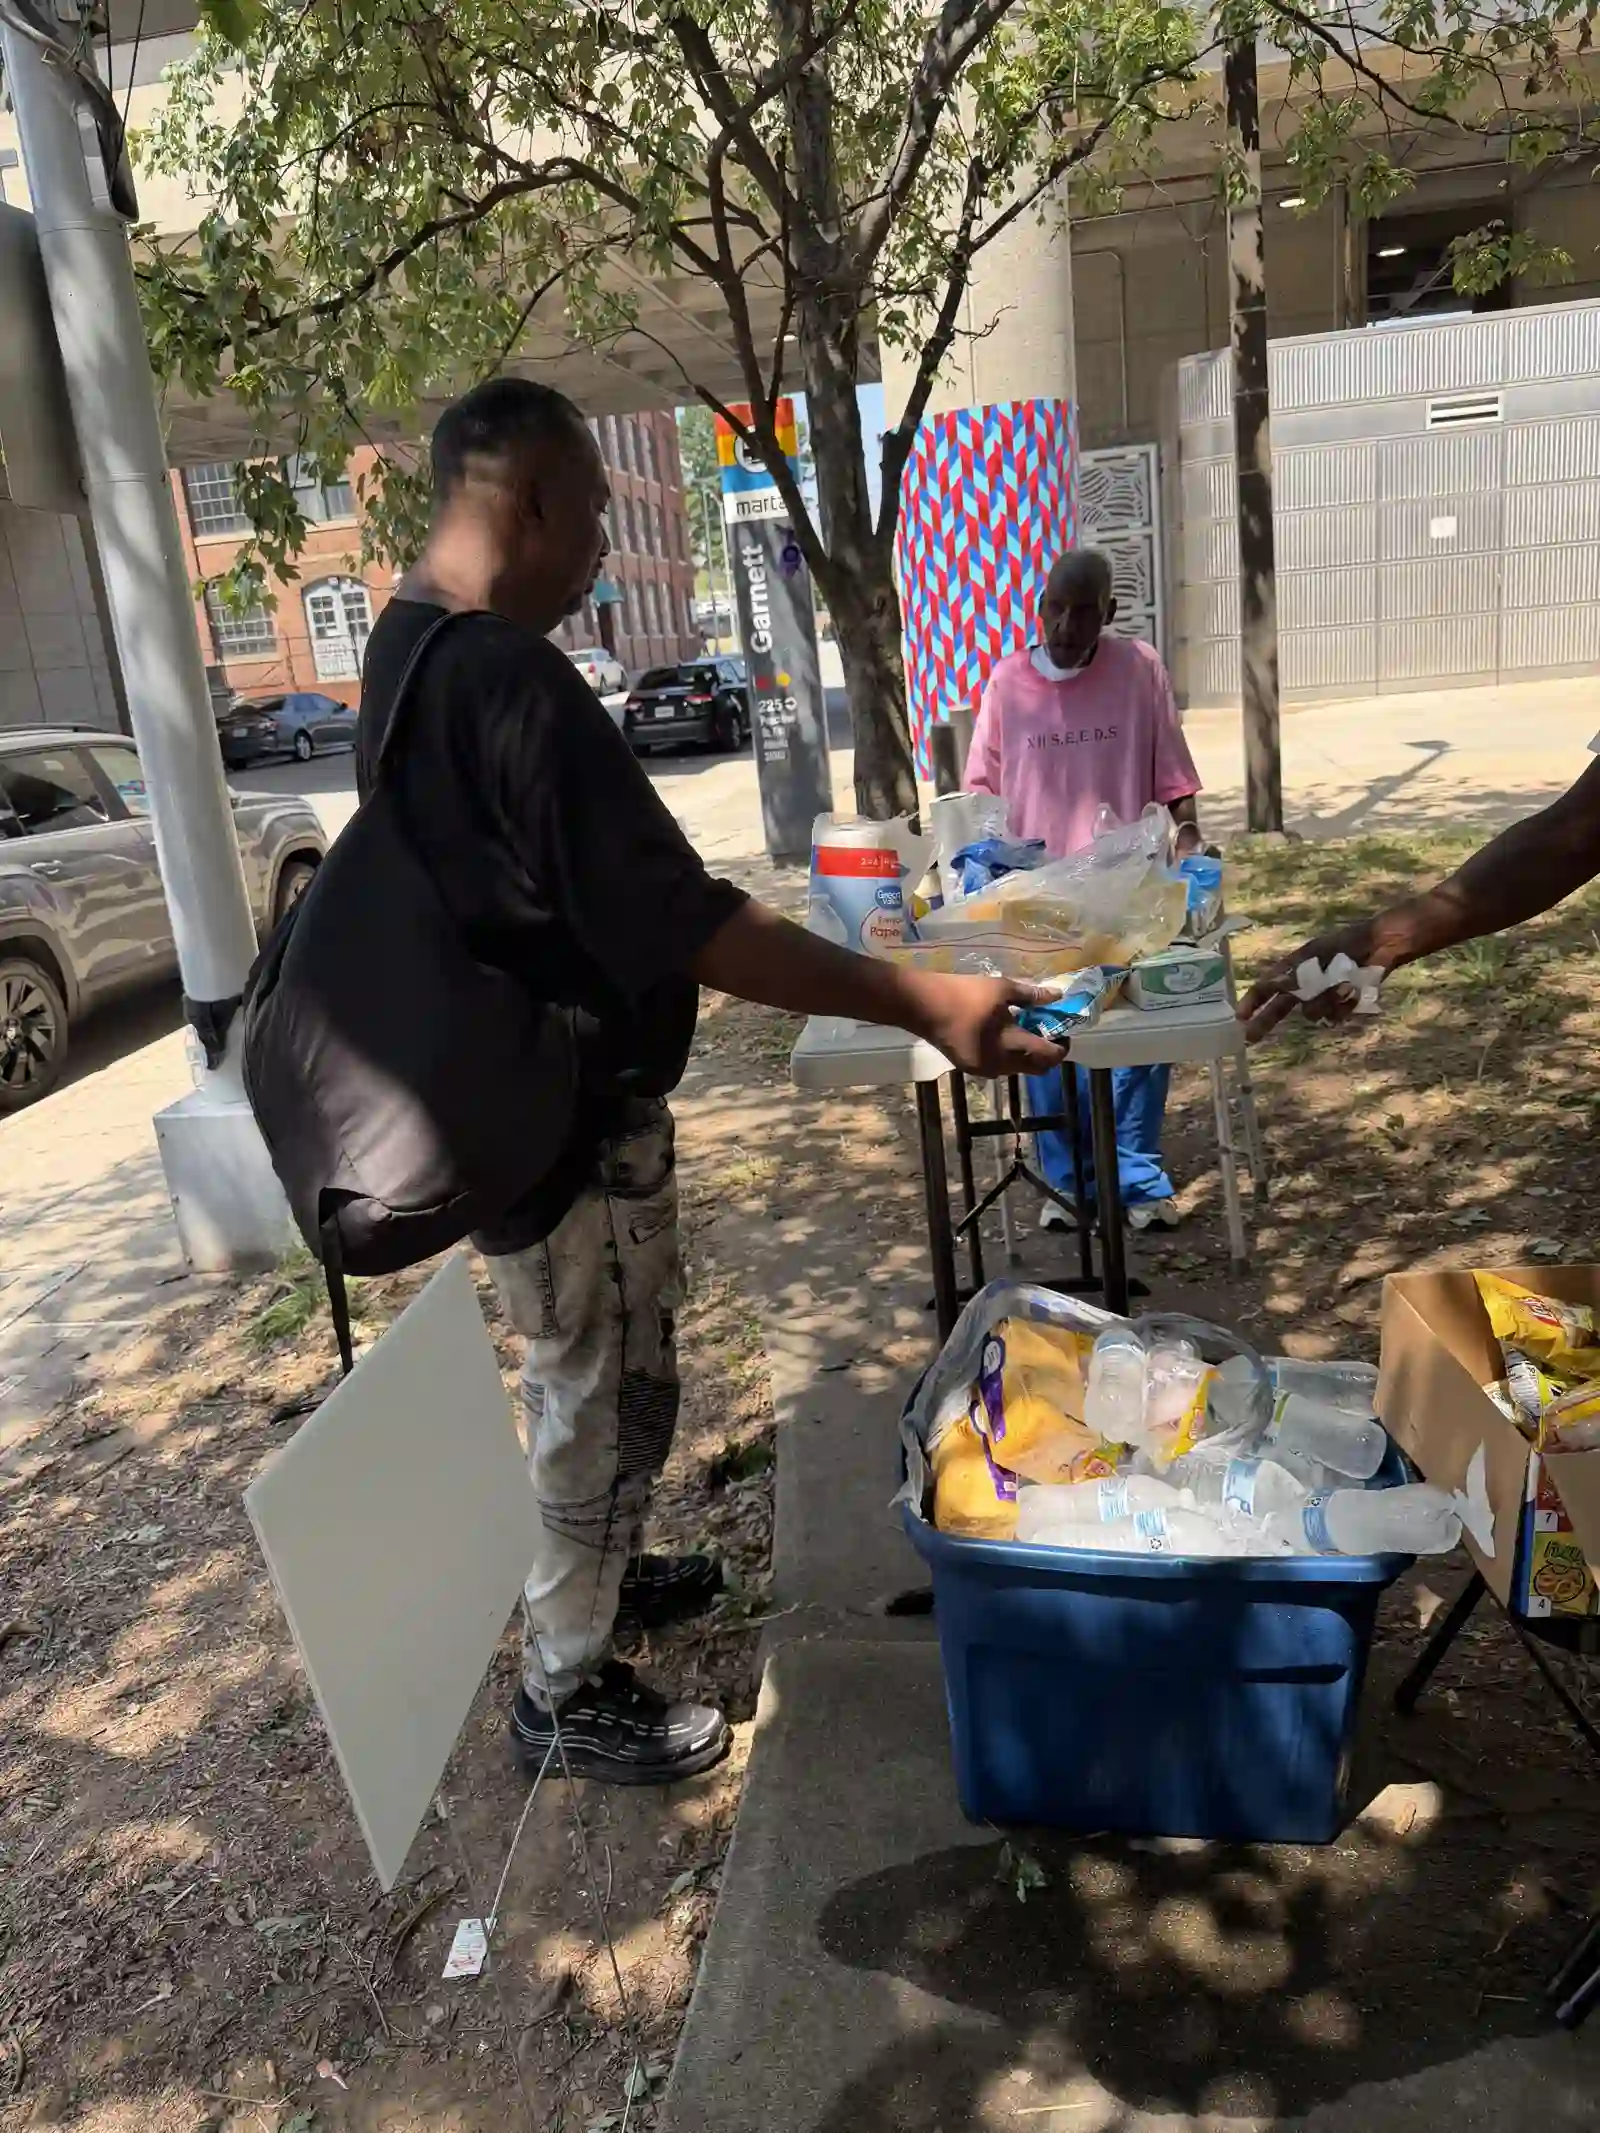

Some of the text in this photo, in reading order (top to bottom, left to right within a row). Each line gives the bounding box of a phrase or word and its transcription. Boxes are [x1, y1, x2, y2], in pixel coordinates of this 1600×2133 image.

[736, 495, 787, 516] marta
[741, 543, 773, 654] Garnett
[758, 698, 783, 713] 225
[869, 925, 900, 940] Pape
[1544, 1512, 1552, 1524] 7
[1537, 1598, 1545, 1609] 4
